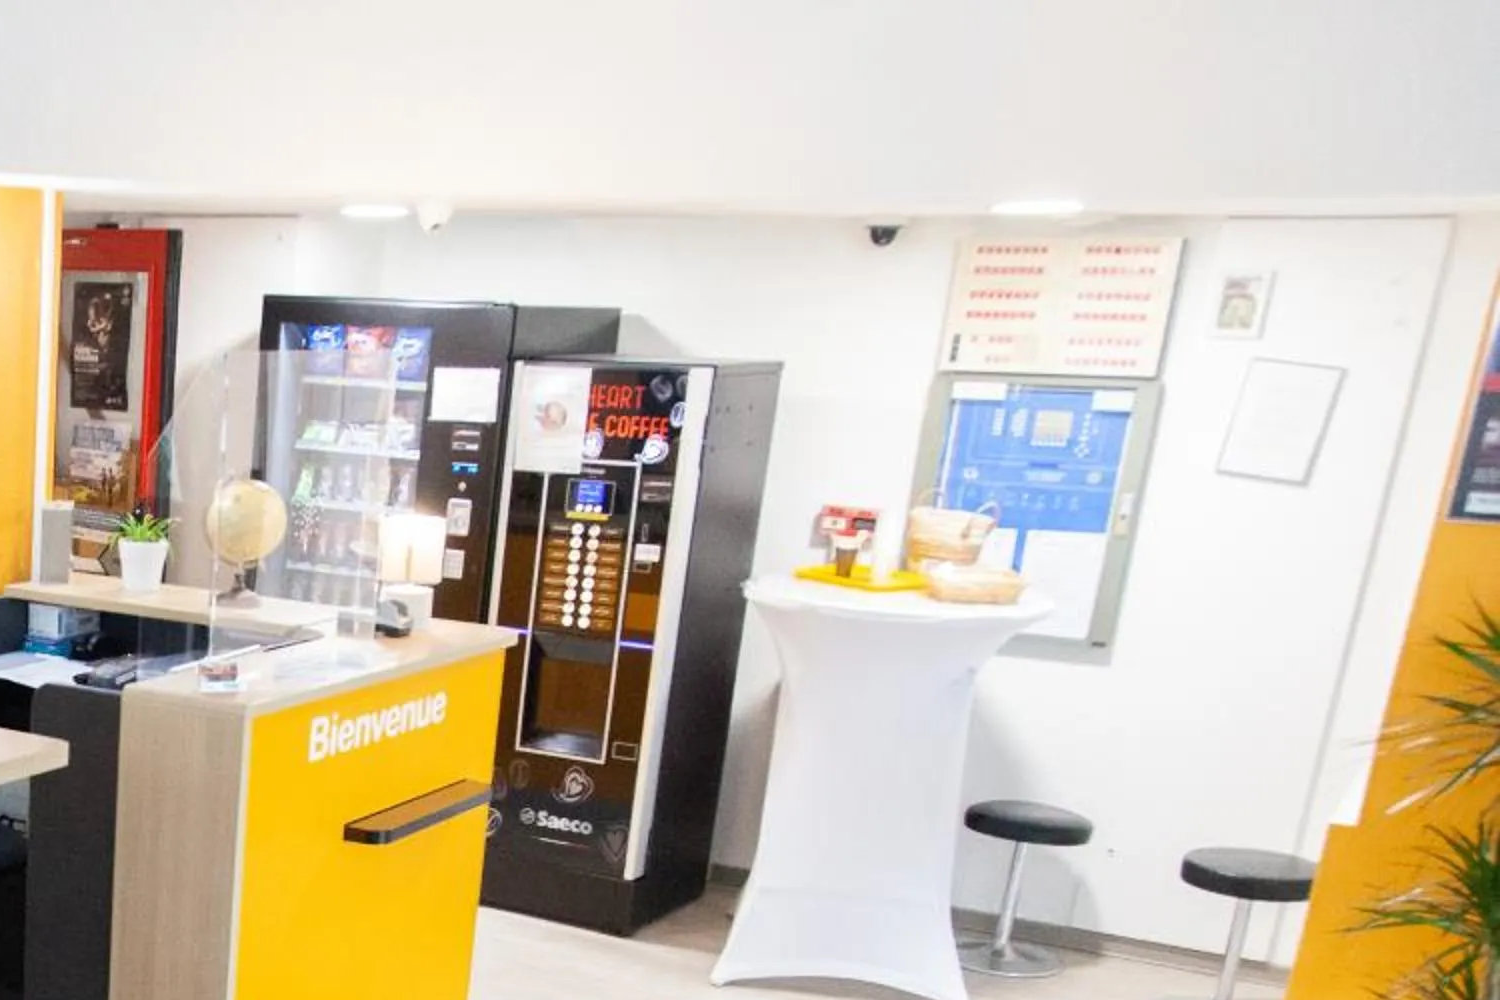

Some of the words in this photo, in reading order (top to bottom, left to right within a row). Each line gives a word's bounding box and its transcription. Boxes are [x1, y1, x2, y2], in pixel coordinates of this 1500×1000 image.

[605, 416, 669, 440] COFFEE
[308, 690, 448, 762] Bienvenue
[536, 810, 593, 835] Saeco
